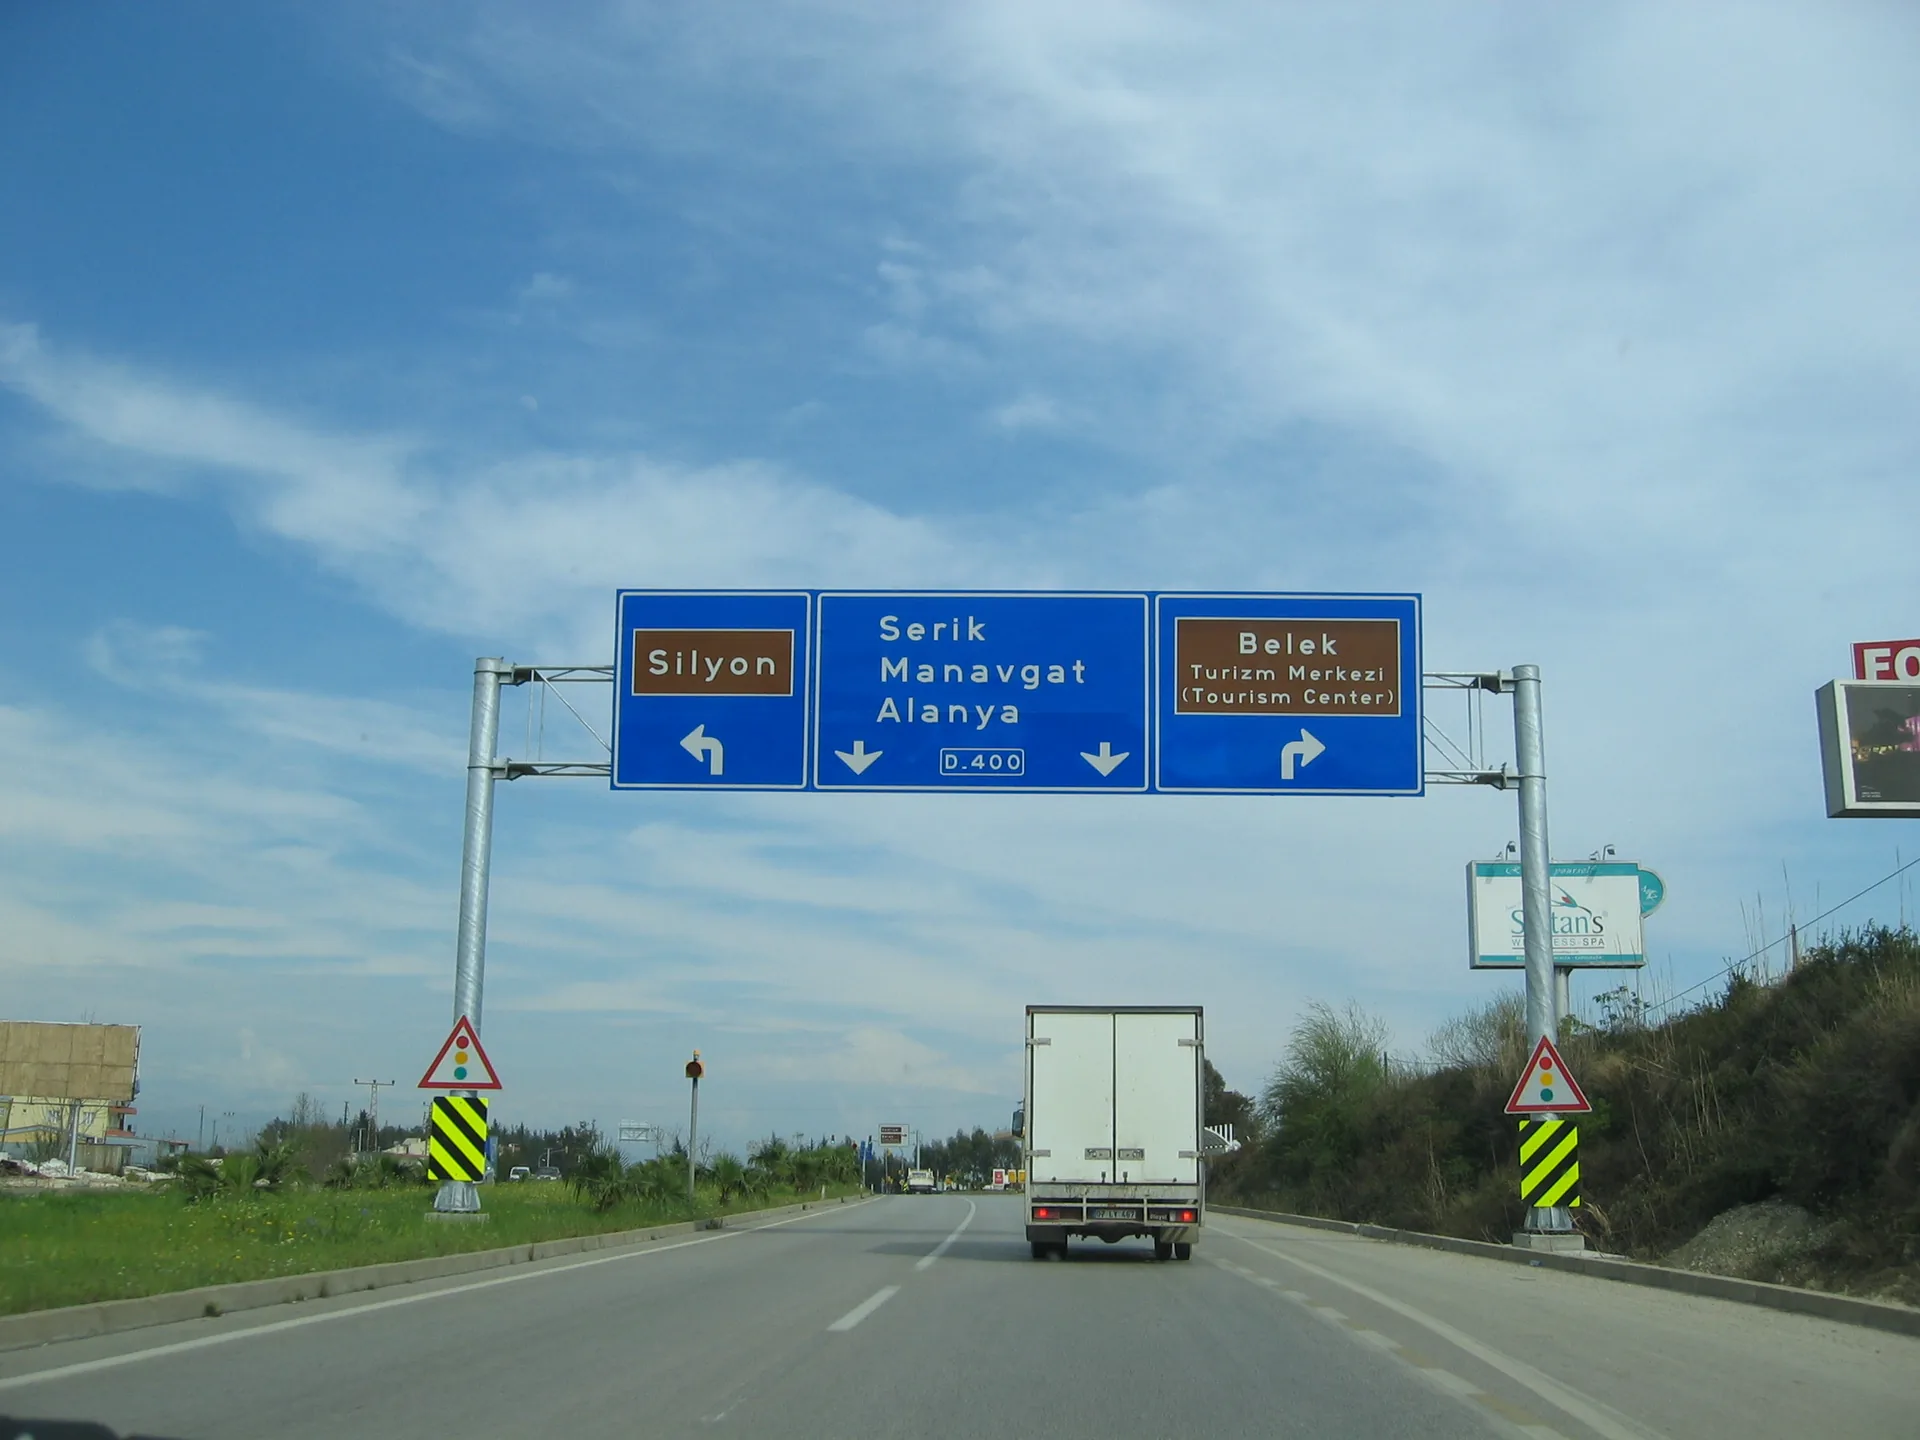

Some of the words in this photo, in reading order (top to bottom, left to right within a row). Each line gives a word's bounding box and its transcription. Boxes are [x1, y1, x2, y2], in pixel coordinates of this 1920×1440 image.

[879, 615, 986, 641] Serik
[1239, 632, 1338, 655] Belek
[648, 649, 775, 682] Silyon
[881, 656, 1086, 690] Manavgat
[1190, 664, 1275, 681] Turizm
[1288, 665, 1383, 682] Merkezi
[1182, 686, 1291, 704] (Tourism
[1303, 688, 1394, 705] Center)
[876, 697, 1019, 731] Alanya
[1511, 908, 1604, 934] Stan's
